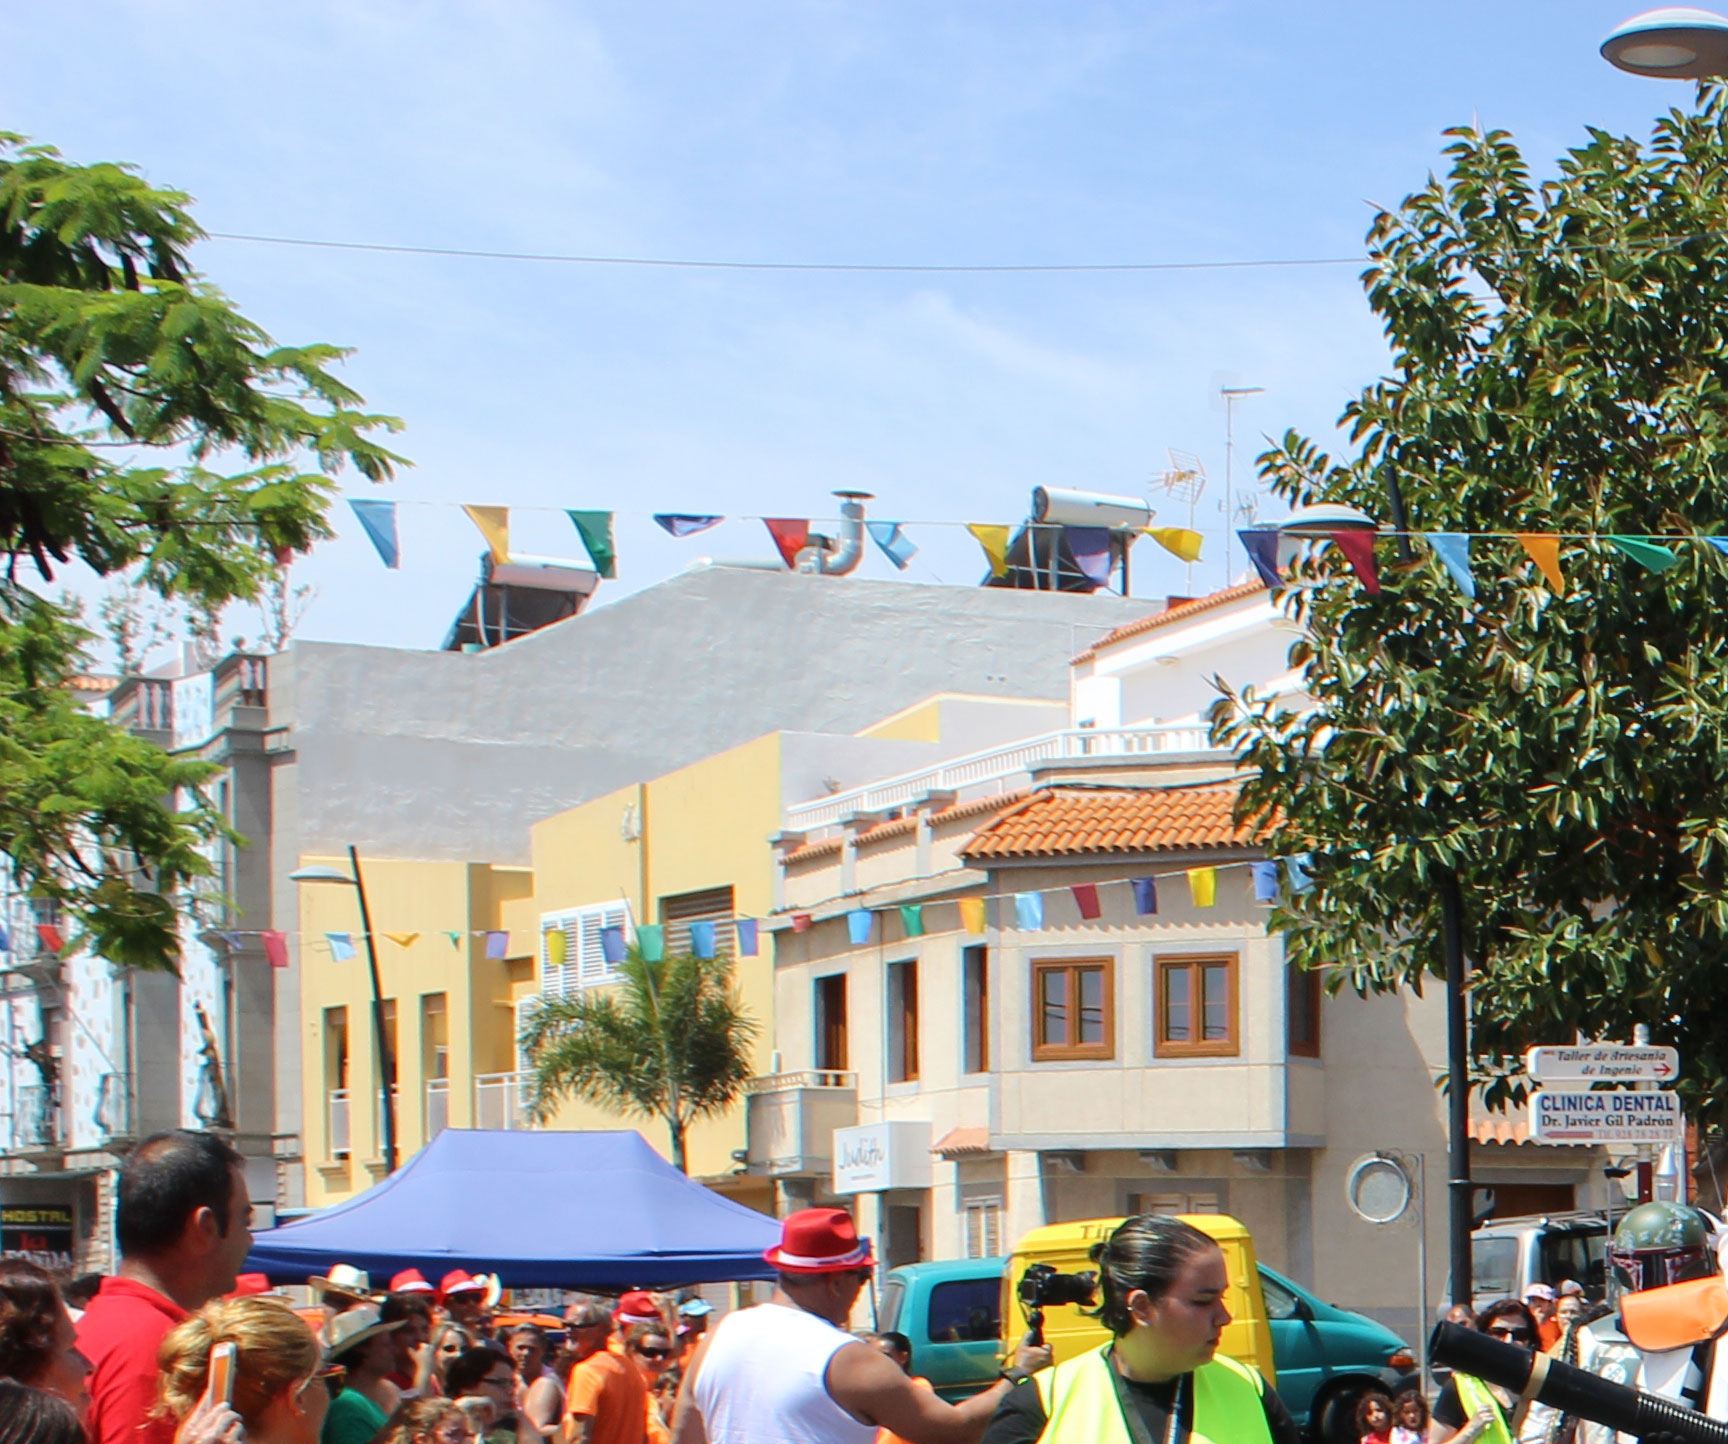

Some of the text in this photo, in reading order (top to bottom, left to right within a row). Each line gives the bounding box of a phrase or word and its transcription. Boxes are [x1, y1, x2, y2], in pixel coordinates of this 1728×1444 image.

[1557, 1051, 1591, 1061] Taller
[1594, 1051, 1607, 1061] de
[1581, 1064, 1643, 1076] de Ingenio
[1541, 1096, 1674, 1111] CLINICA DENTAL
[1542, 1115, 1673, 1128] Dr. Javier Gil Padrón
